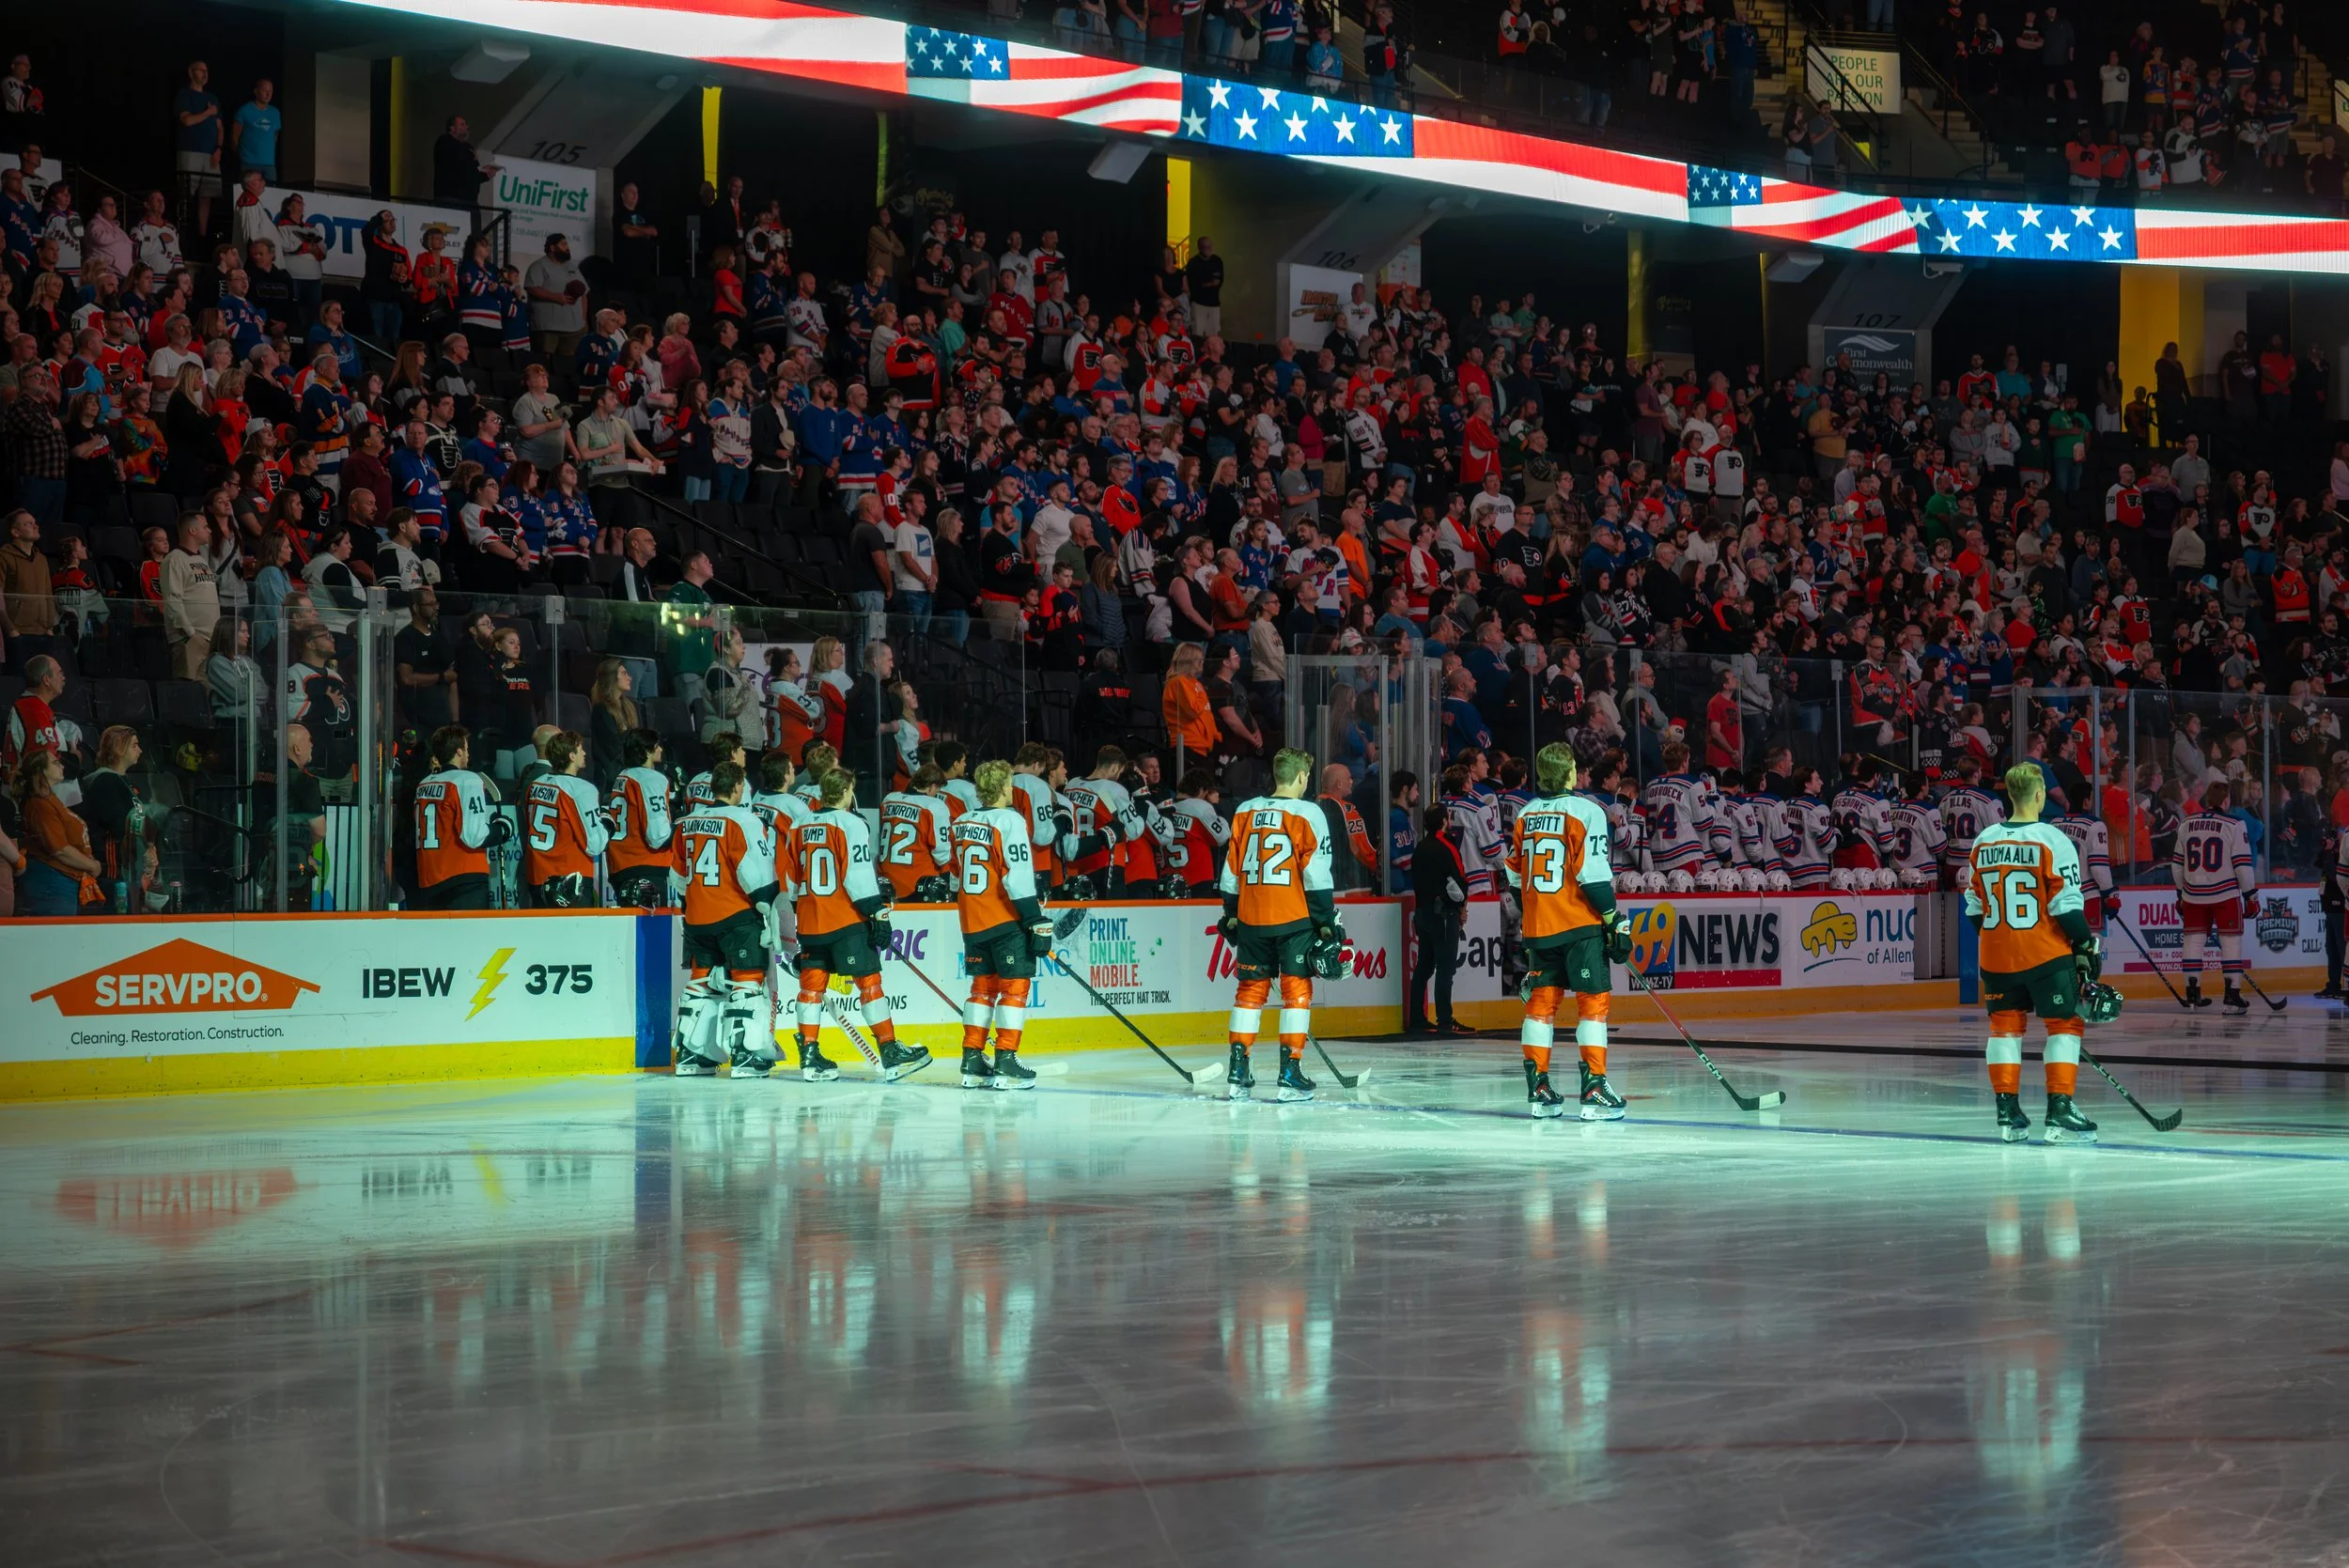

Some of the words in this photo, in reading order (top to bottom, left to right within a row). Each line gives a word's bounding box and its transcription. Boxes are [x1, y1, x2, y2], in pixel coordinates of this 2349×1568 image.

[1830, 54, 1877, 71] PEOPLE
[1855, 74, 1884, 88] OUR
[530, 141, 586, 163] 105
[499, 175, 588, 212] UniFirst
[1316, 250, 1361, 269] 106
[1854, 313, 1902, 329] 107
[1843, 347, 1866, 358] First
[468, 796, 485, 815] 41
[1037, 805, 1053, 822] 86
[1255, 812, 1277, 827] GILL
[1348, 819, 1364, 833] 25
[2188, 819, 2223, 834] MORROW
[852, 845, 871, 862] 20
[1008, 844, 1029, 862] 96
[1589, 834, 1609, 857] 73
[2186, 836, 2224, 873] 60
[1241, 832, 1293, 887] 42
[1980, 847, 2034, 865] TUOMAALA
[1981, 869, 2040, 930] 56
[2059, 862, 2080, 887] 56
[2139, 903, 2180, 925] DUAL
[1090, 918, 1130, 941] PRINT.
[2257, 918, 2298, 932] PREMIUM
[1630, 902, 1676, 975] 69
[1678, 912, 1780, 965] NEWS
[2155, 933, 2178, 945] HOME
[1090, 941, 1141, 965] ONLINE.
[1867, 948, 1879, 965] of
[363, 967, 456, 999] IBEW
[524, 964, 593, 996] 375
[1090, 964, 1143, 987] MOBILE.
[1106, 993, 1135, 1005] PERFECT
[1137, 991, 1150, 1003] HAT
[1151, 991, 1172, 1003] TRICK.
[70, 1032, 129, 1046] Cleaning.
[132, 1028, 206, 1042] Restoration.
[208, 1025, 285, 1040] Construction.
[1701, 1053, 1723, 1080] CCM
[2099, 1065, 2128, 1097] CCM
[1592, 1091, 1612, 1107] CCM
